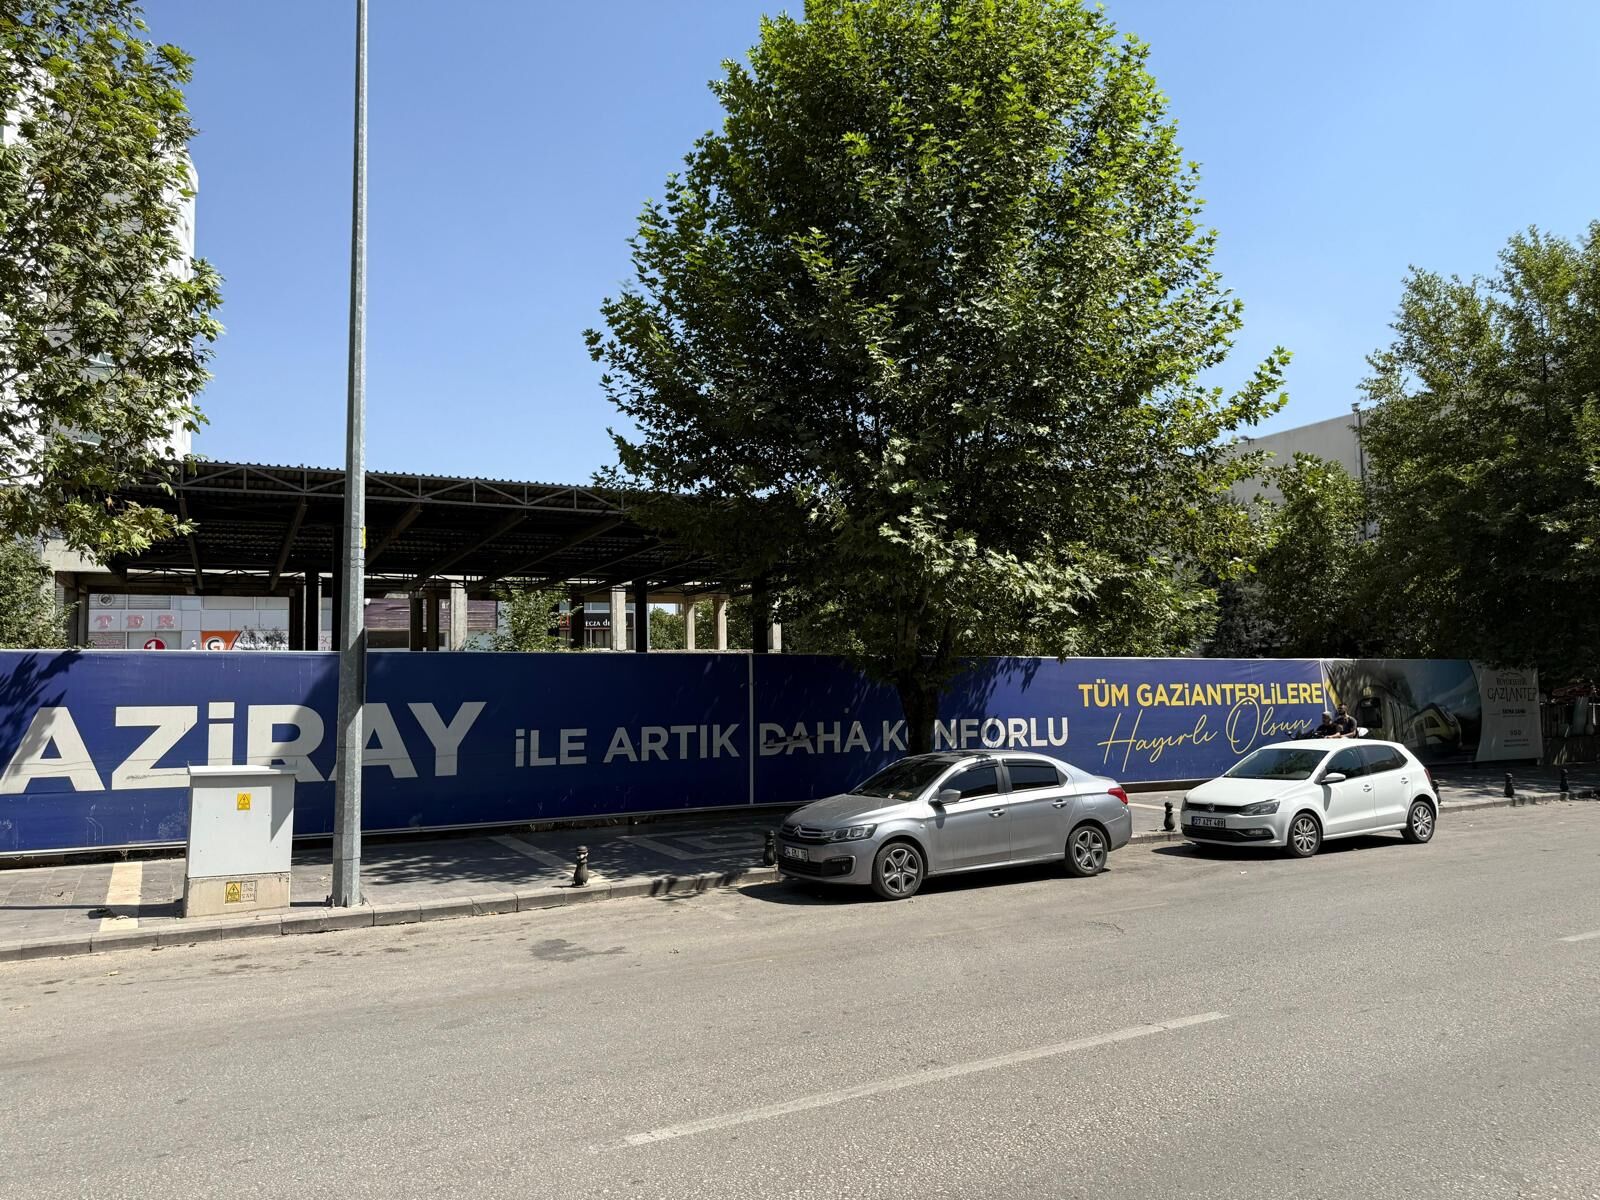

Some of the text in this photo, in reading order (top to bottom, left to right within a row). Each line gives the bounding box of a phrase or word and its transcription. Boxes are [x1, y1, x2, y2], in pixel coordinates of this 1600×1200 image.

[1078, 679, 1129, 708] TÜM
[602, 723, 740, 764] ARTIK
[759, 719, 871, 756] DAHA
[883, 716, 1069, 752] KNFORLU
[1226, 697, 1313, 755] Olsun
